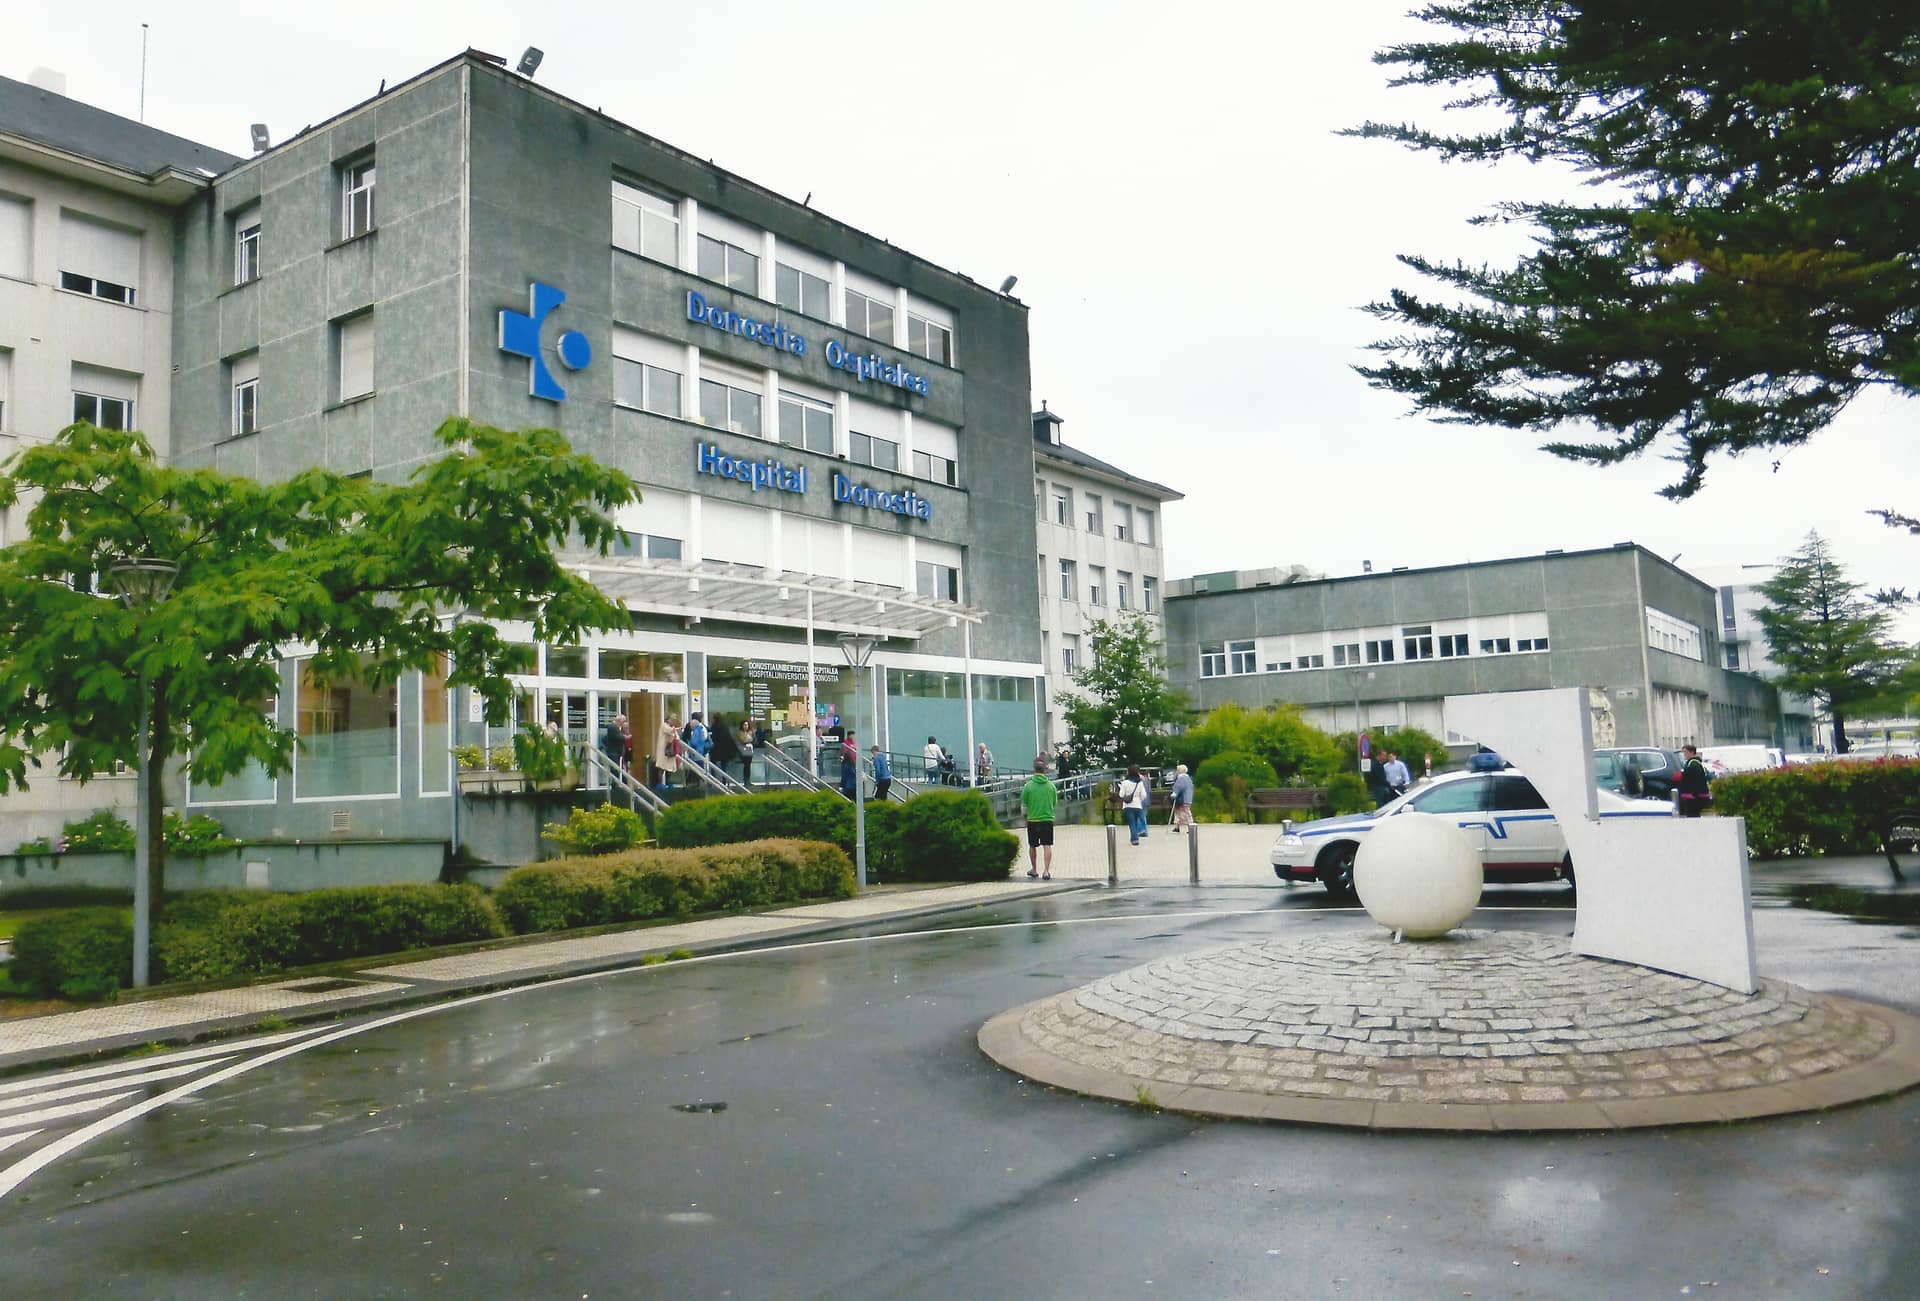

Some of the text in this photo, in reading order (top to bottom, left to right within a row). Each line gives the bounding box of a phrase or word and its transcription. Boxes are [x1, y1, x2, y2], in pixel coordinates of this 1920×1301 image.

[687, 290, 929, 396] Donostia Ospitalea
[698, 442, 932, 520] Hospital Donostia
